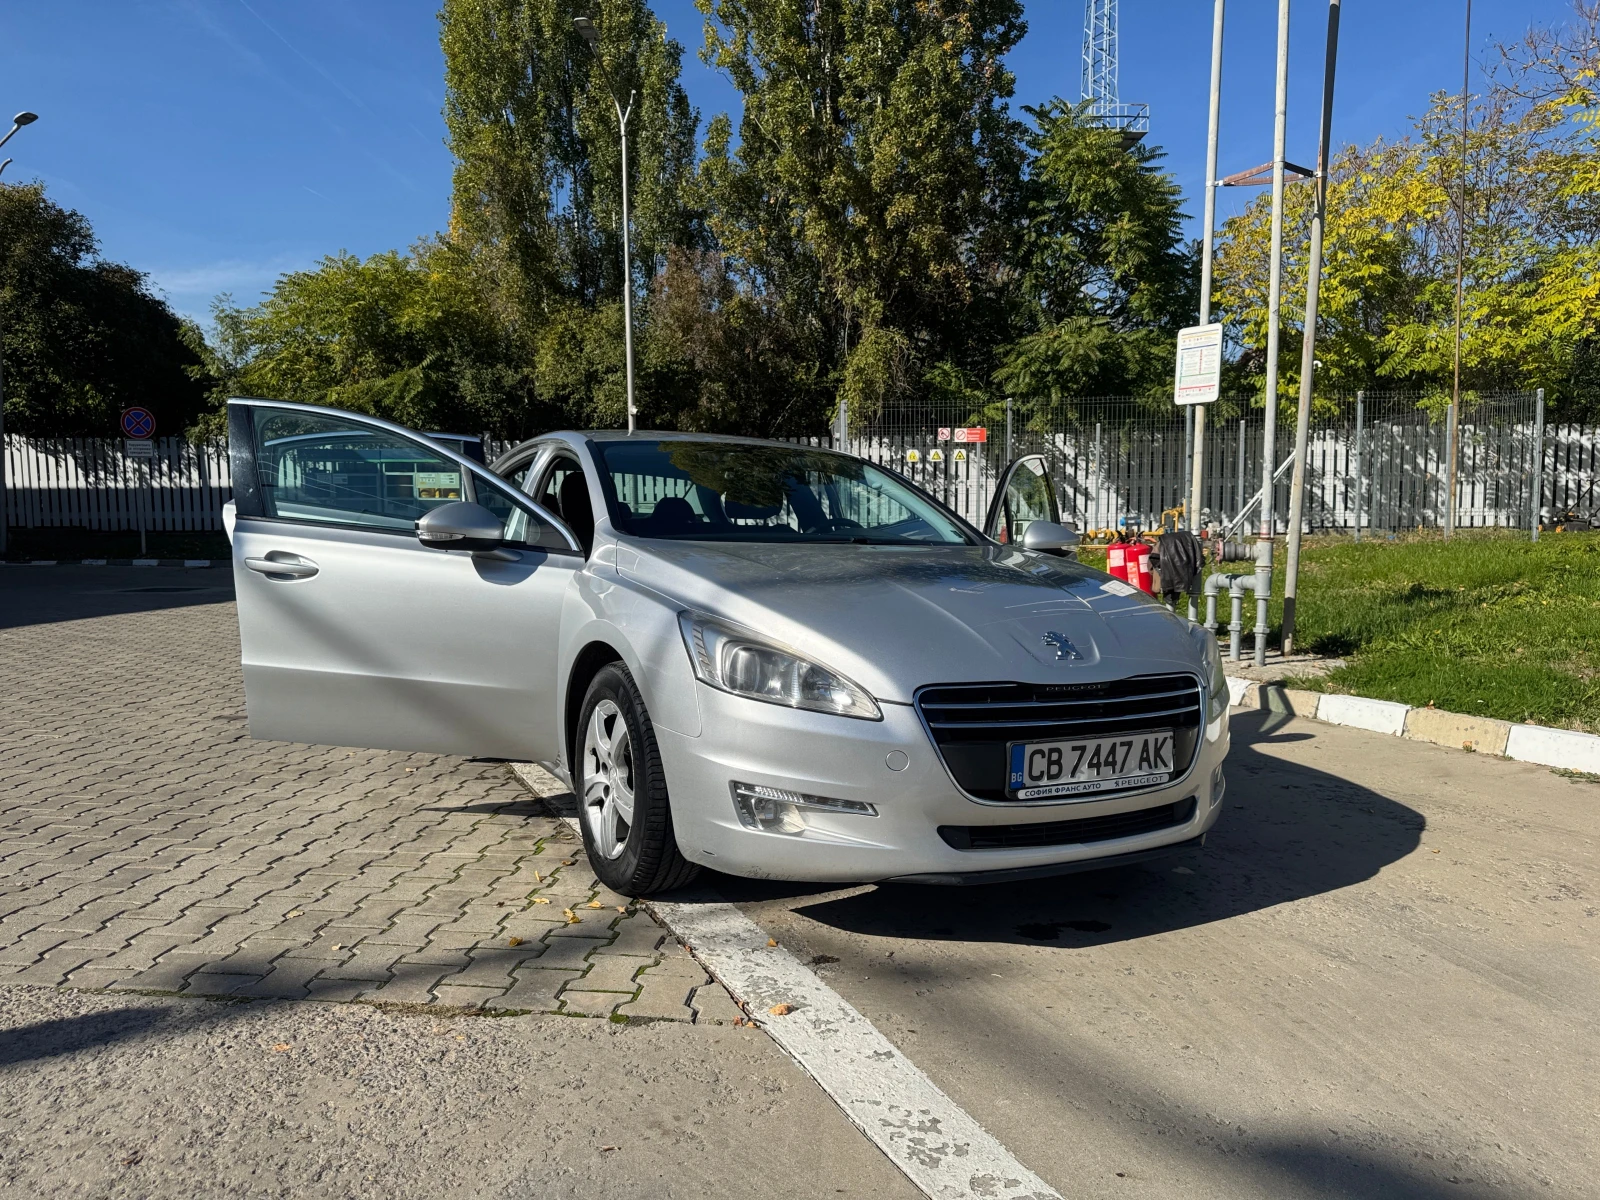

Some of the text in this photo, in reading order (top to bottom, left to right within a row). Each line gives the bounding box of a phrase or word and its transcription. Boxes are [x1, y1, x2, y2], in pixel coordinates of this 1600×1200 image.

[1028, 736, 1169, 782] CB 7447 AK
[1011, 772, 1023, 783] BG
[1121, 775, 1165, 787] PEUGEOT
[1024, 783, 1102, 798] СОФИЯ ФРАНС АУТО
